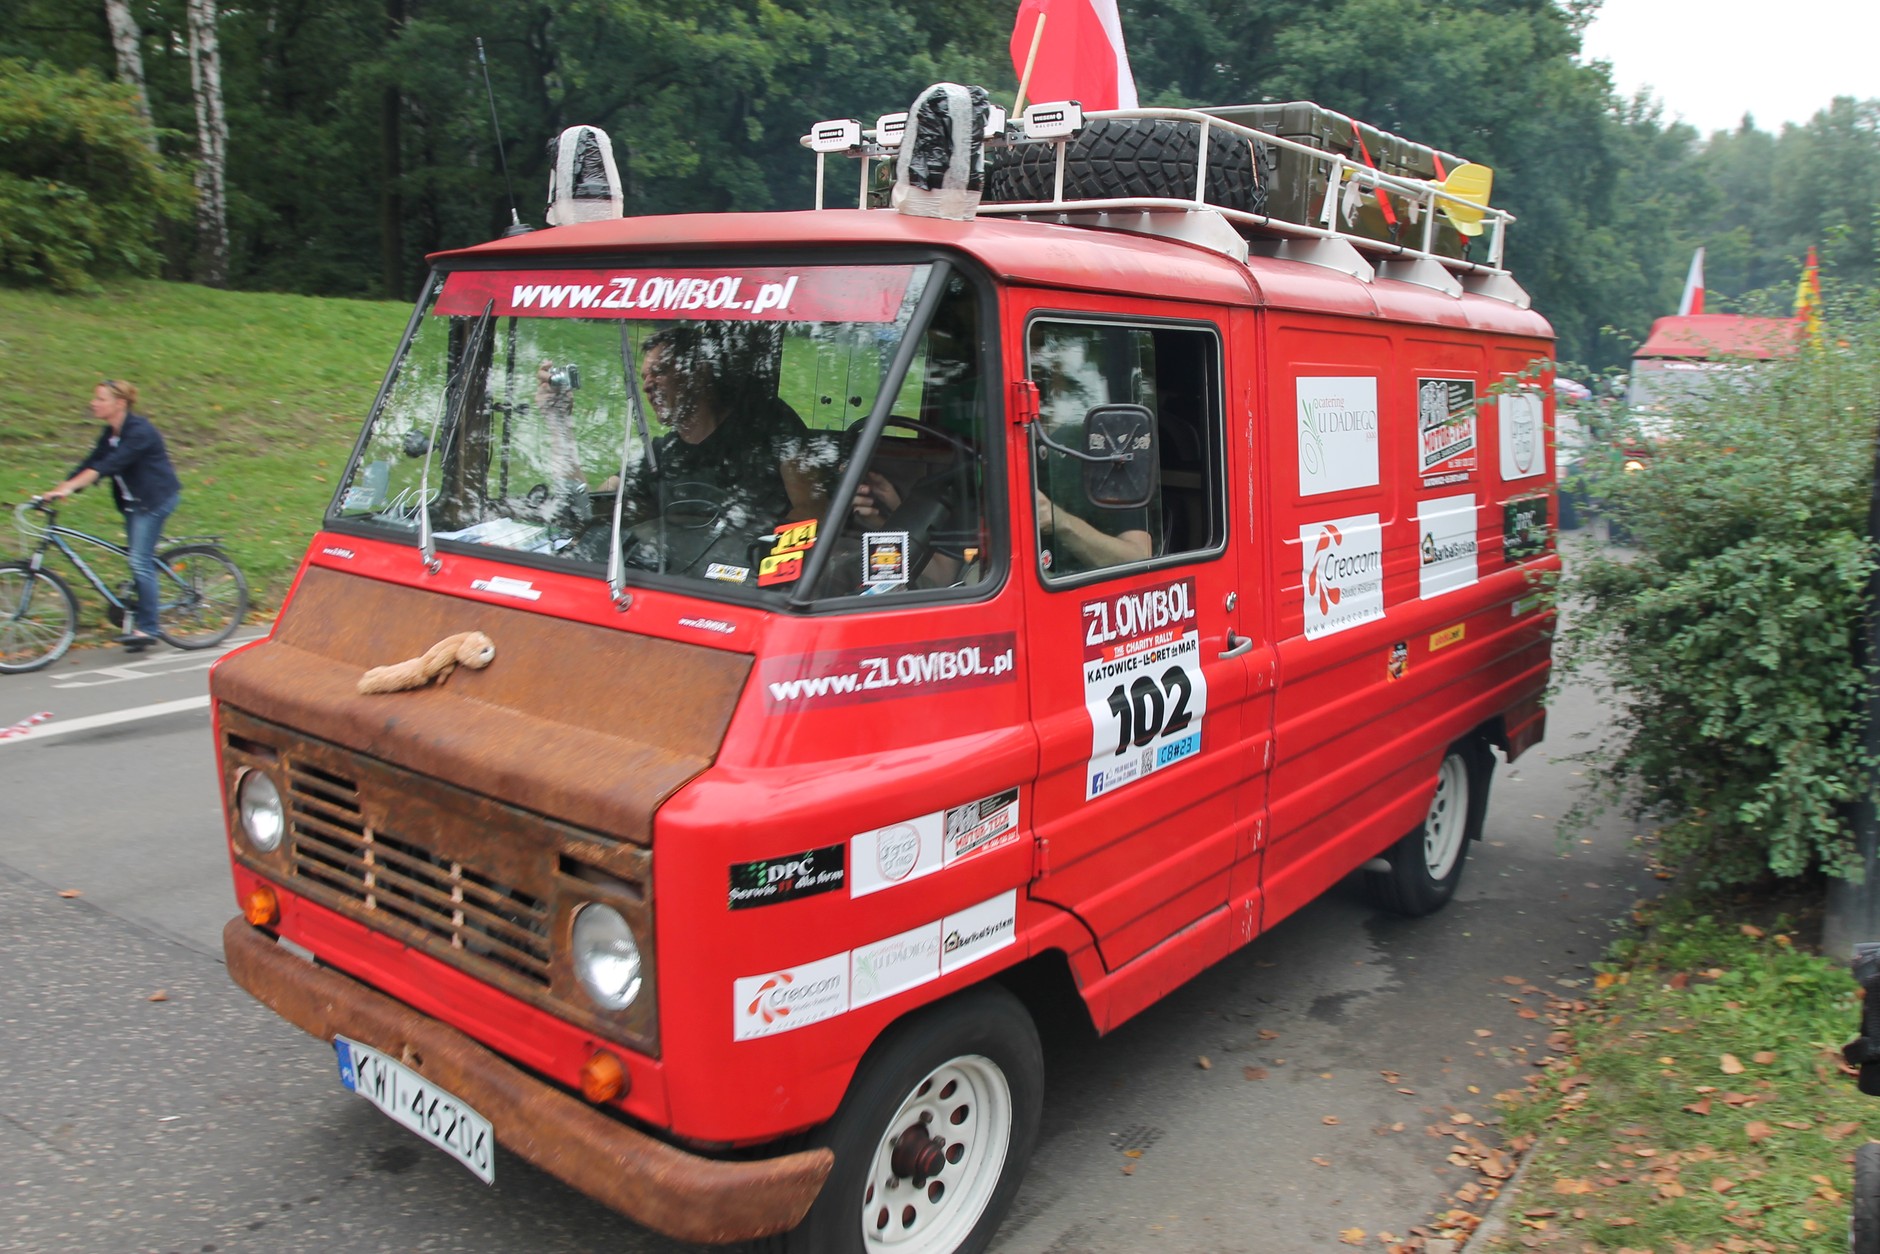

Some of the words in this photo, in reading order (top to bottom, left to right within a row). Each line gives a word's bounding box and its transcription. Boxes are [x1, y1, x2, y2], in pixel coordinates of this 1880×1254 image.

[1034, 113, 1056, 122] WESEM
[510, 276, 798, 314] www.ZLOMBOL.pl
[1318, 394, 1345, 411] catering
[1318, 412, 1327, 434] U
[1329, 410, 1377, 433] DADIEGO
[1324, 551, 1379, 581] Creocom
[1083, 583, 1195, 647] ZLOMBOL
[1114, 646, 1125, 659] THE
[1126, 636, 1154, 654] CHARITY
[1154, 630, 1174, 646] RALLY
[1170, 646, 1178, 657] de
[1178, 639, 1197, 654] MAR
[768, 646, 1014, 702] www.ZLOMBOL.pl
[1107, 665, 1193, 756] 102
[955, 811, 1009, 851] MOTOR-TECH
[766, 857, 815, 883] DPC
[728, 882, 778, 900] Serwis
[769, 975, 841, 1008] Creocom
[353, 1049, 398, 1112] KWI
